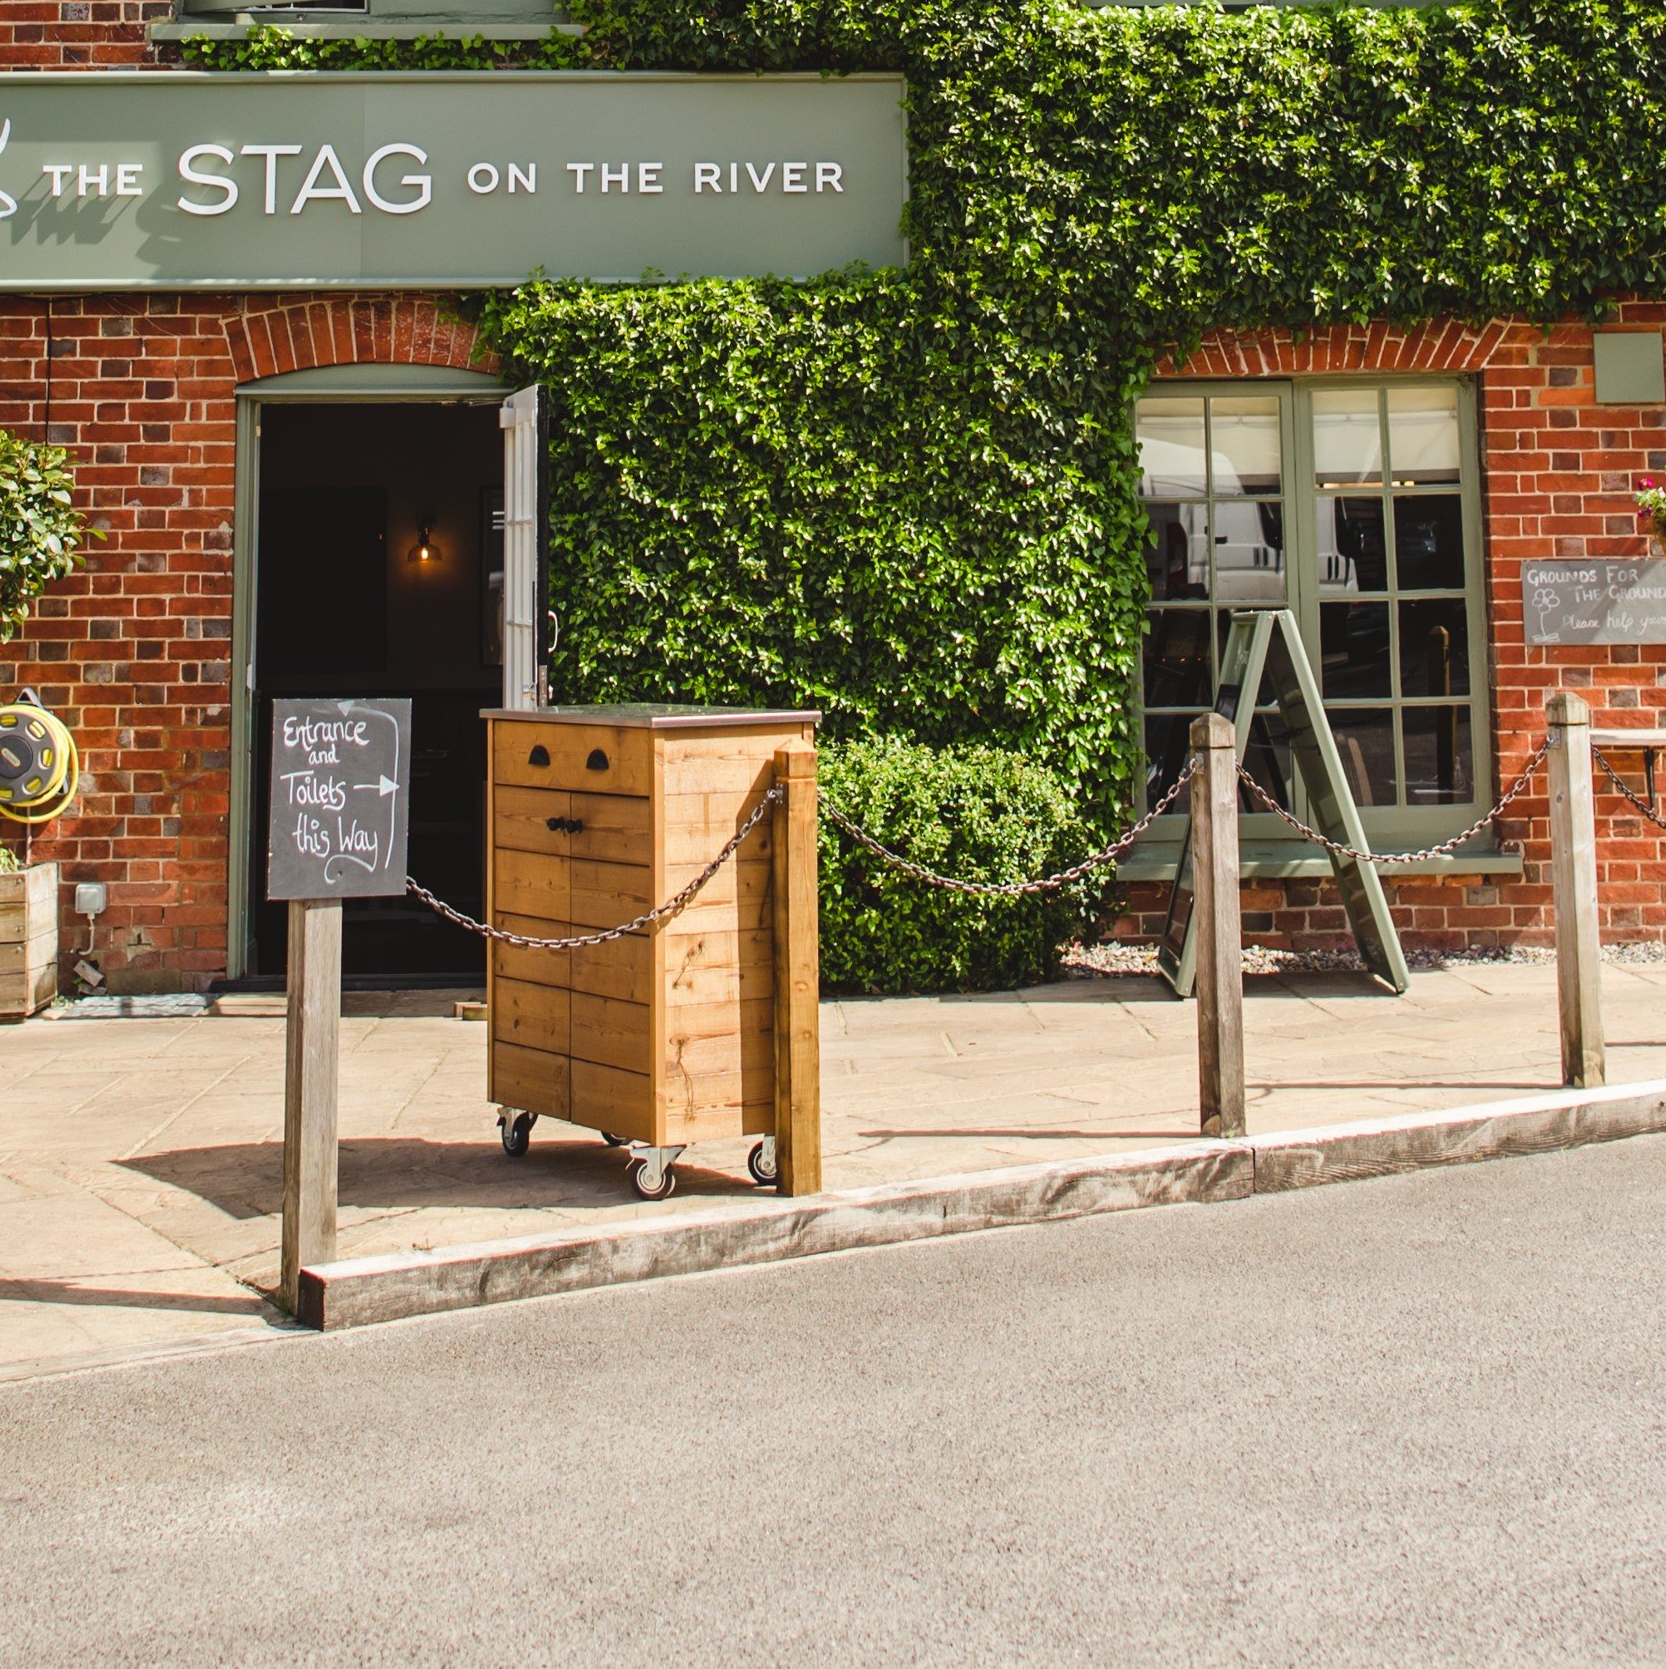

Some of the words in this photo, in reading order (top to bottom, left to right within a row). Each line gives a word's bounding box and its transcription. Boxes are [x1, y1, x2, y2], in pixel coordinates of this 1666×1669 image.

[42, 163, 143, 197] THE
[177, 142, 432, 215] STAG
[467, 162, 537, 194] ON
[566, 162, 664, 194] THE
[694, 162, 844, 194] RIVER
[1527, 569, 1598, 587] GROUNDS
[1606, 565, 1639, 583] FOR
[1575, 585, 1601, 603] THE
[1563, 613, 1601, 629] Please
[1606, 609, 1634, 633] help
[283, 716, 371, 751] Entrance
[308, 744, 341, 765] and
[280, 770, 347, 811] Toilets
[292, 812, 331, 858] this
[338, 815, 378, 872] Way
